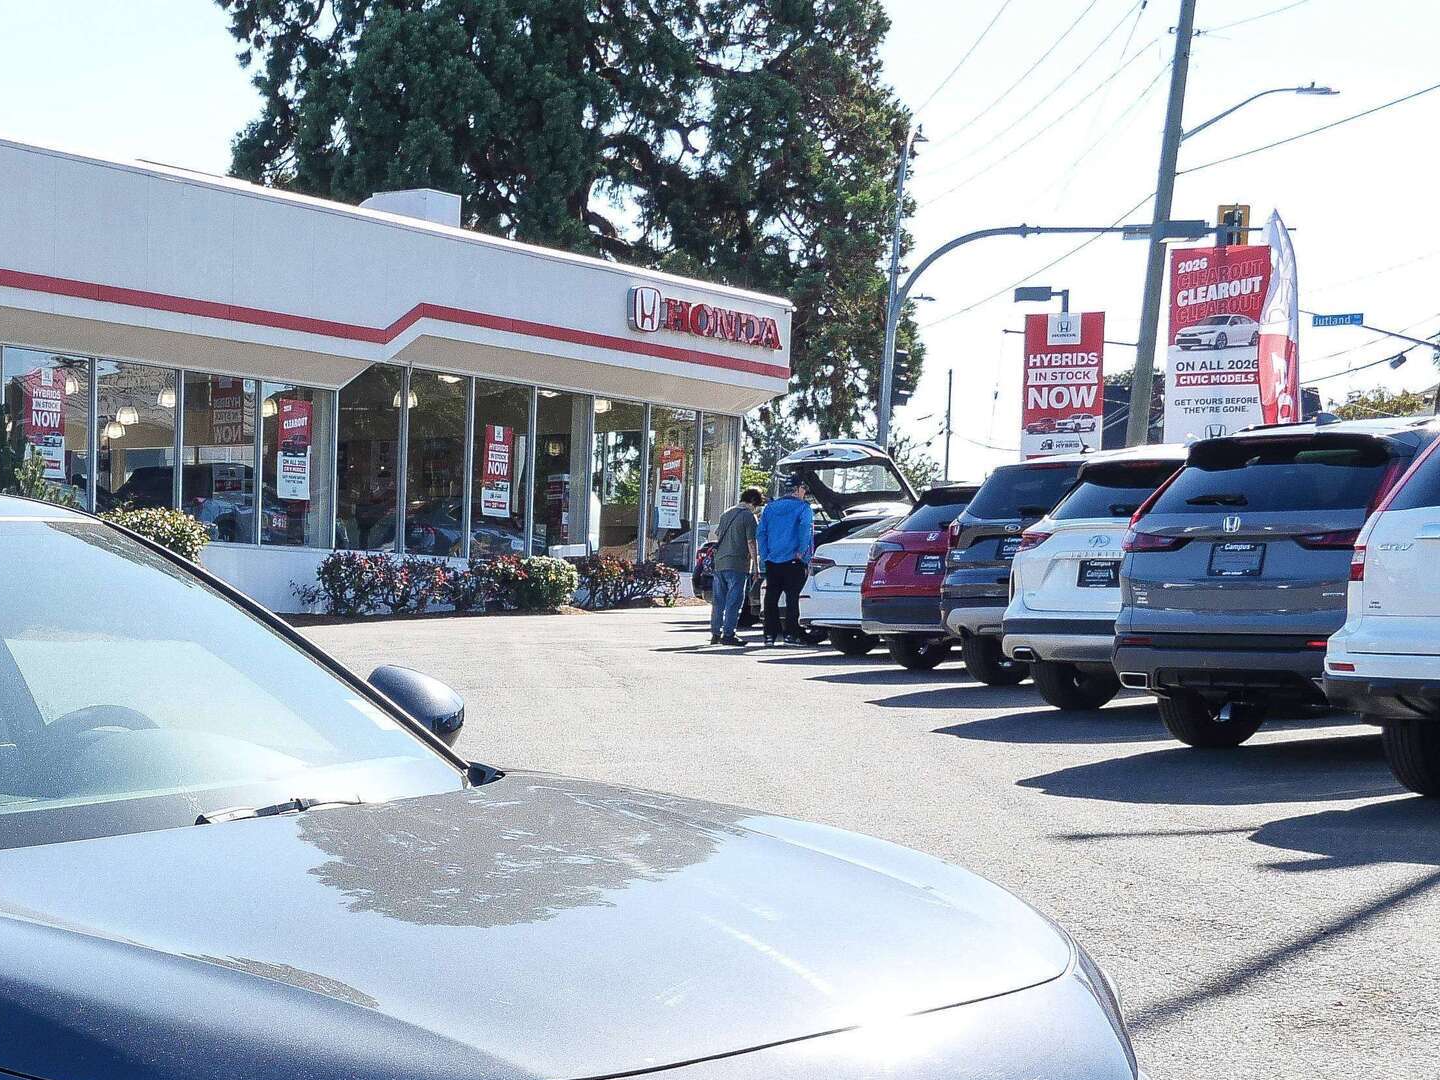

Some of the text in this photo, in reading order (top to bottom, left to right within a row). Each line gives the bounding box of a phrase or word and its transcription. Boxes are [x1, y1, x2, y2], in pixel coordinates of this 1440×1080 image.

[1178, 258, 1208, 274] 2026
[1177, 276, 1263, 306] CLEAROUT
[664, 298, 783, 351] HONDA
[1313, 315, 1351, 326] Jutland
[1029, 352, 1098, 367] HYBRIDS
[1176, 359, 1259, 372] ON ALL 2026
[1035, 371, 1091, 382] IN STOCK
[1180, 373, 1255, 385] CIVIC MODELS
[32, 386, 61, 400] HYBRIDS
[1027, 385, 1098, 410] NOW
[1174, 396, 1259, 407] GET YOURS BEFORE
[1184, 406, 1221, 414] THEY'RE
[32, 410, 61, 428] NOW
[487, 461, 508, 475] NOW
[1224, 543, 1251, 552] Campus
[1090, 560, 1111, 568] Campus
